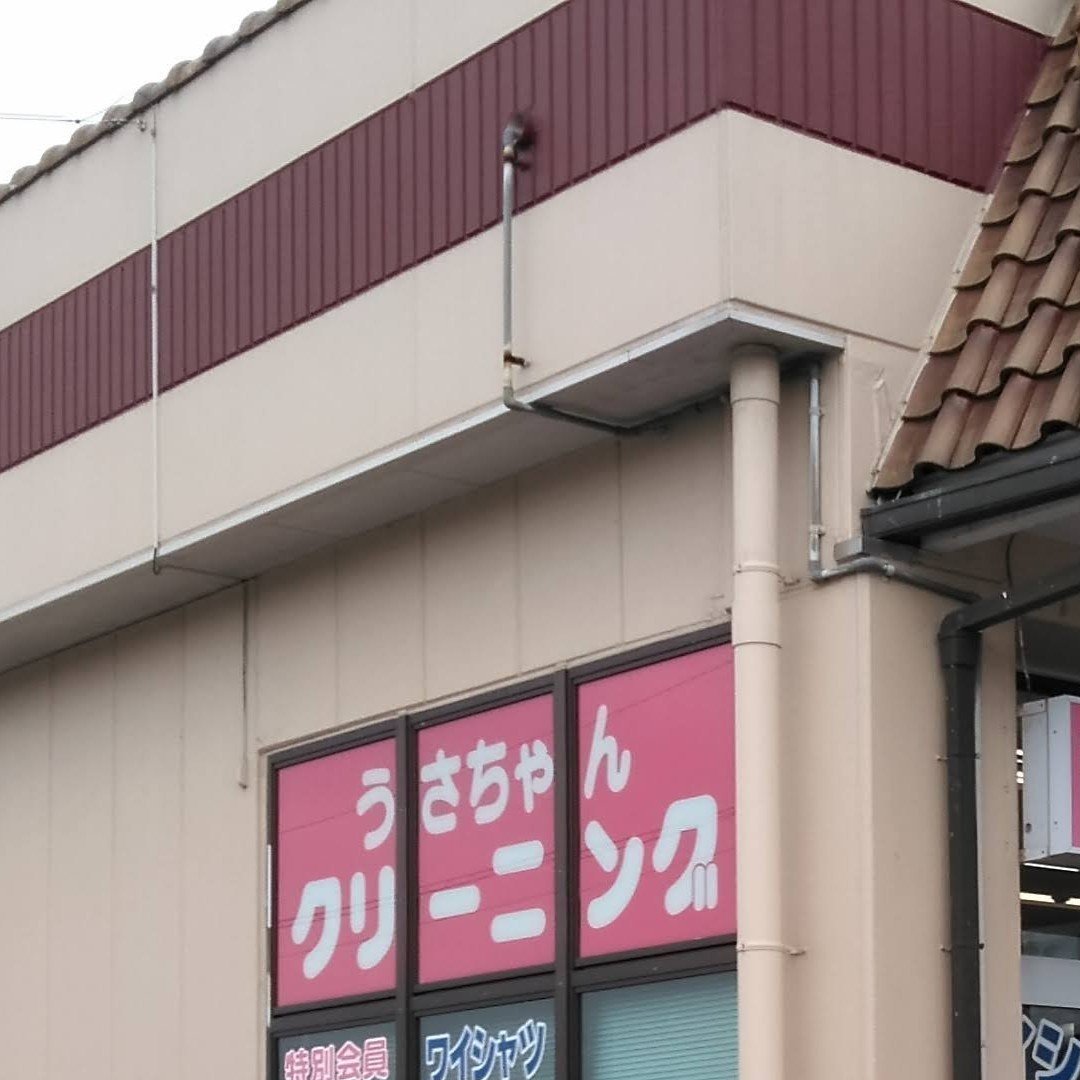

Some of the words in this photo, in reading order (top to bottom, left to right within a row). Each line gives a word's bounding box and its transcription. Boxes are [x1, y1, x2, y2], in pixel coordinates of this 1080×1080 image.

[356, 704, 631, 850] うさちゃん
[291, 794, 719, 979] クリーニング
